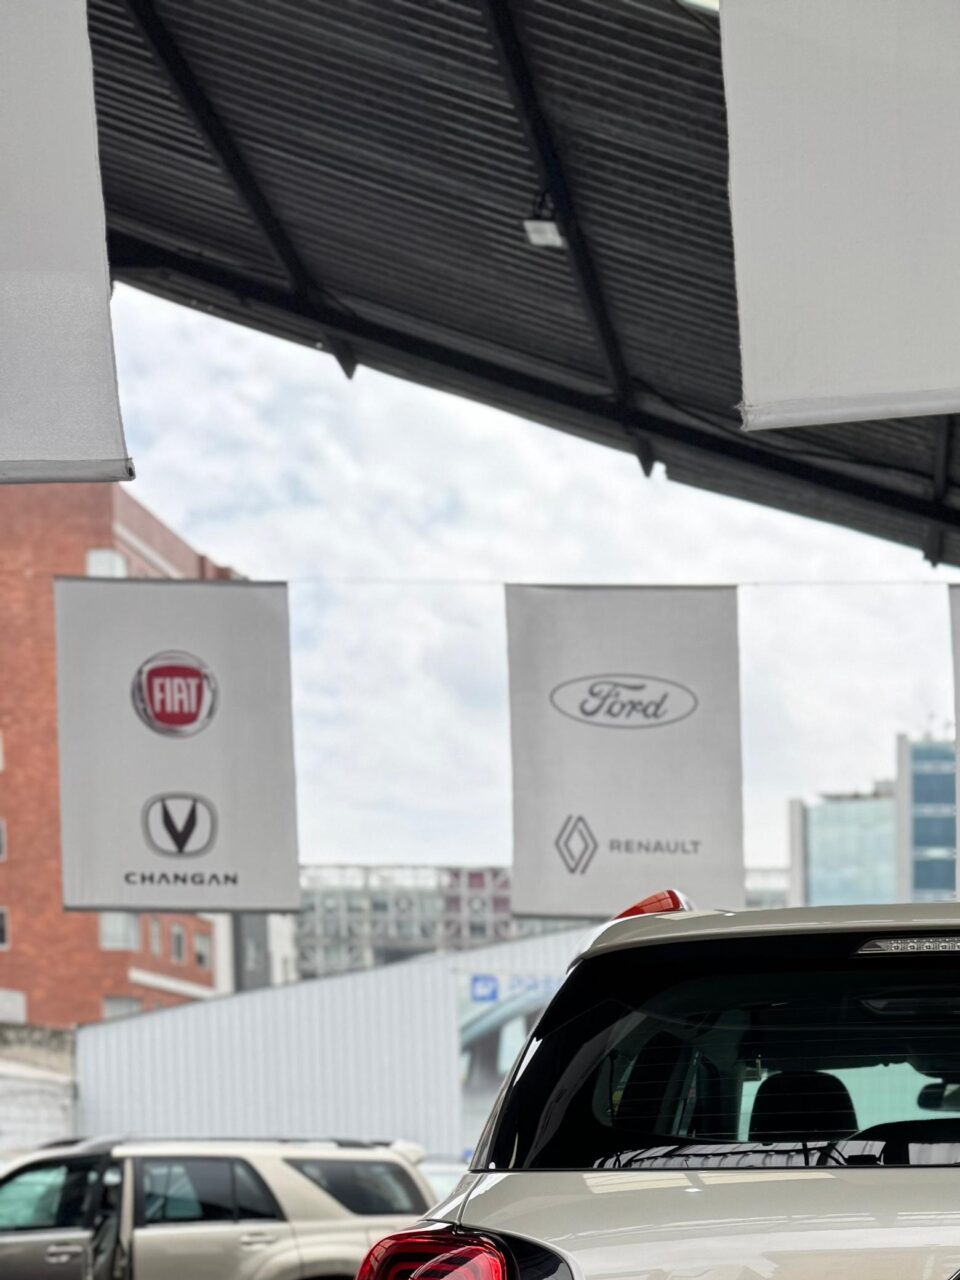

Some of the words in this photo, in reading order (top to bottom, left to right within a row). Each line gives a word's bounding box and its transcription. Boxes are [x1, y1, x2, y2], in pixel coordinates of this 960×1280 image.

[152, 676, 201, 714] FIAT
[579, 680, 669, 719] Ford
[608, 838, 702, 855] RENAULT
[123, 871, 239, 887] CHANGAN
